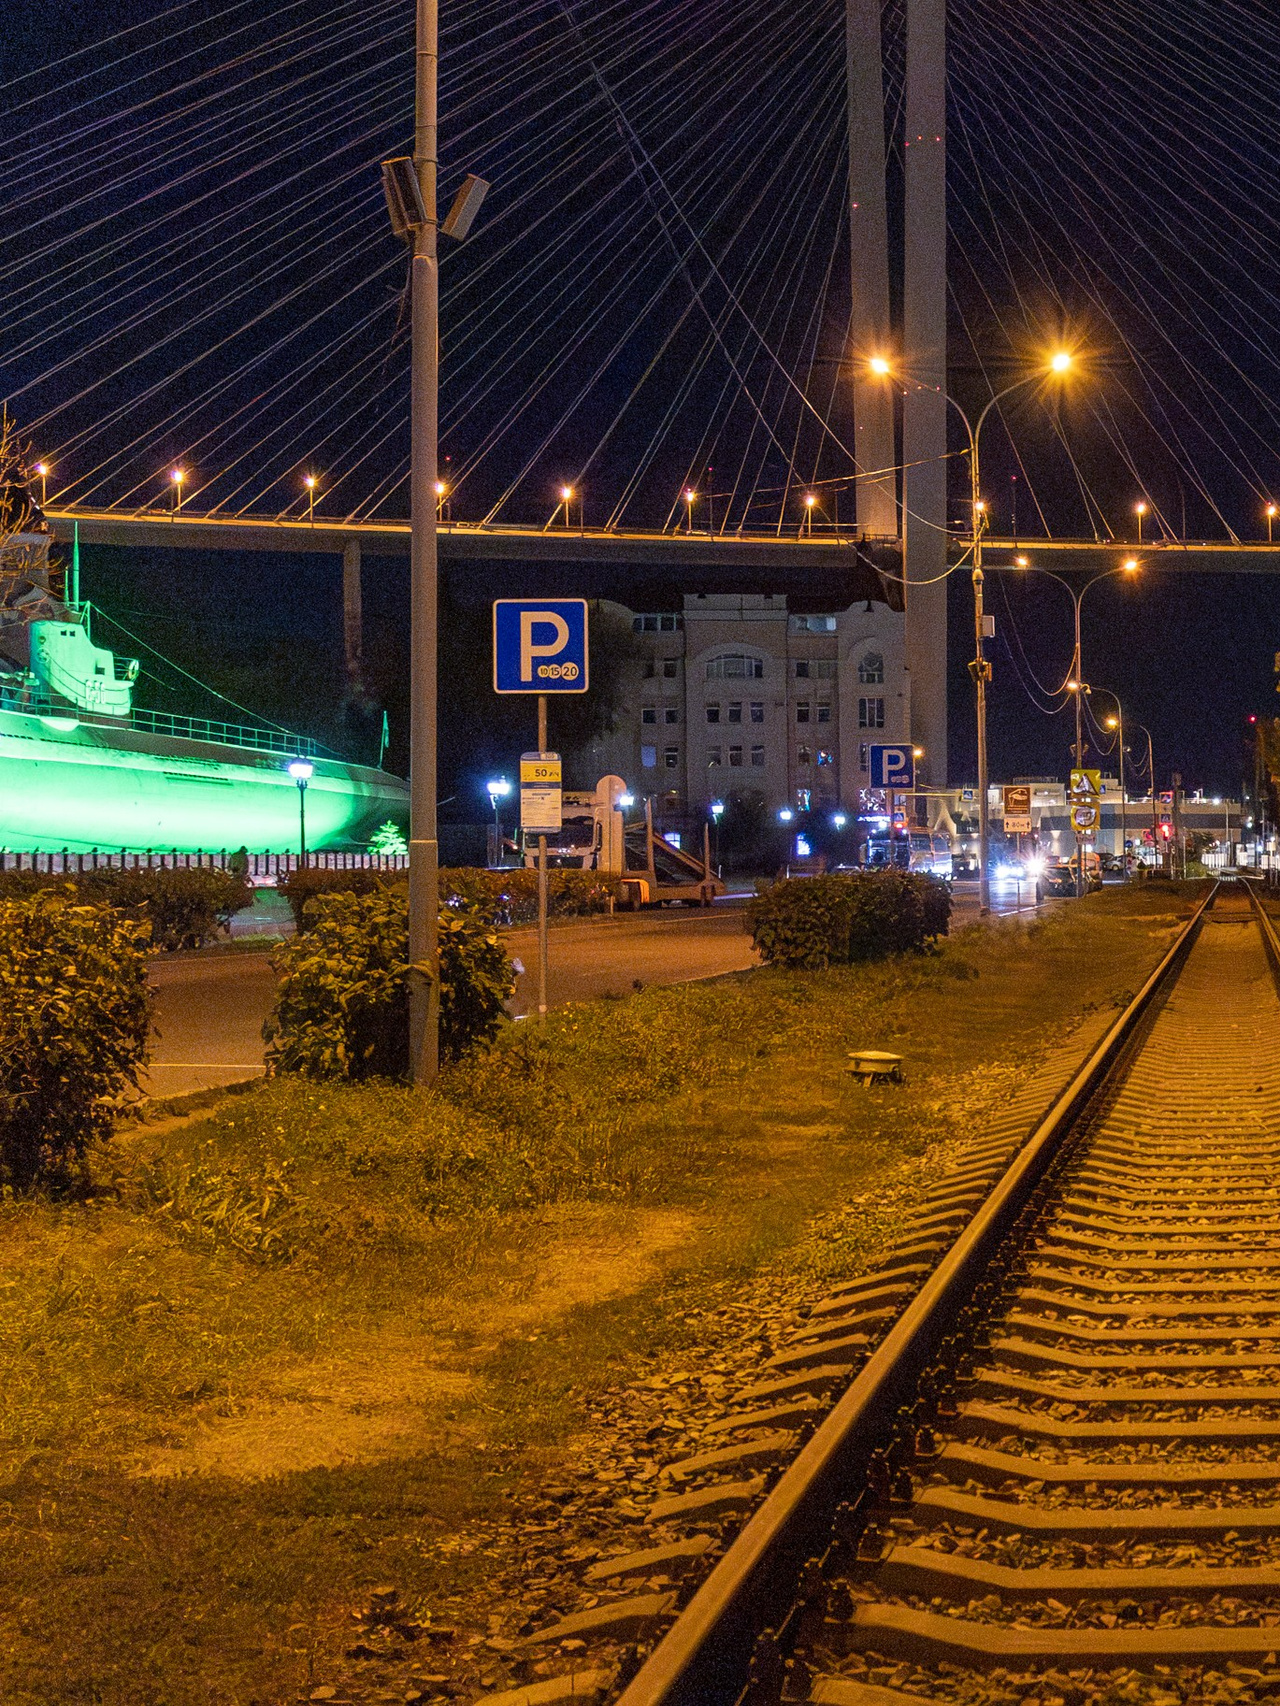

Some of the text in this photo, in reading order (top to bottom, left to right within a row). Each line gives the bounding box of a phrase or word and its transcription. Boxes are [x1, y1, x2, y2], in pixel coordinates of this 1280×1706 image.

[520, 611, 570, 682] P
[540, 666, 578, 677] 10 15 20
[534, 768, 548, 777] 50
[882, 749, 906, 784] P
